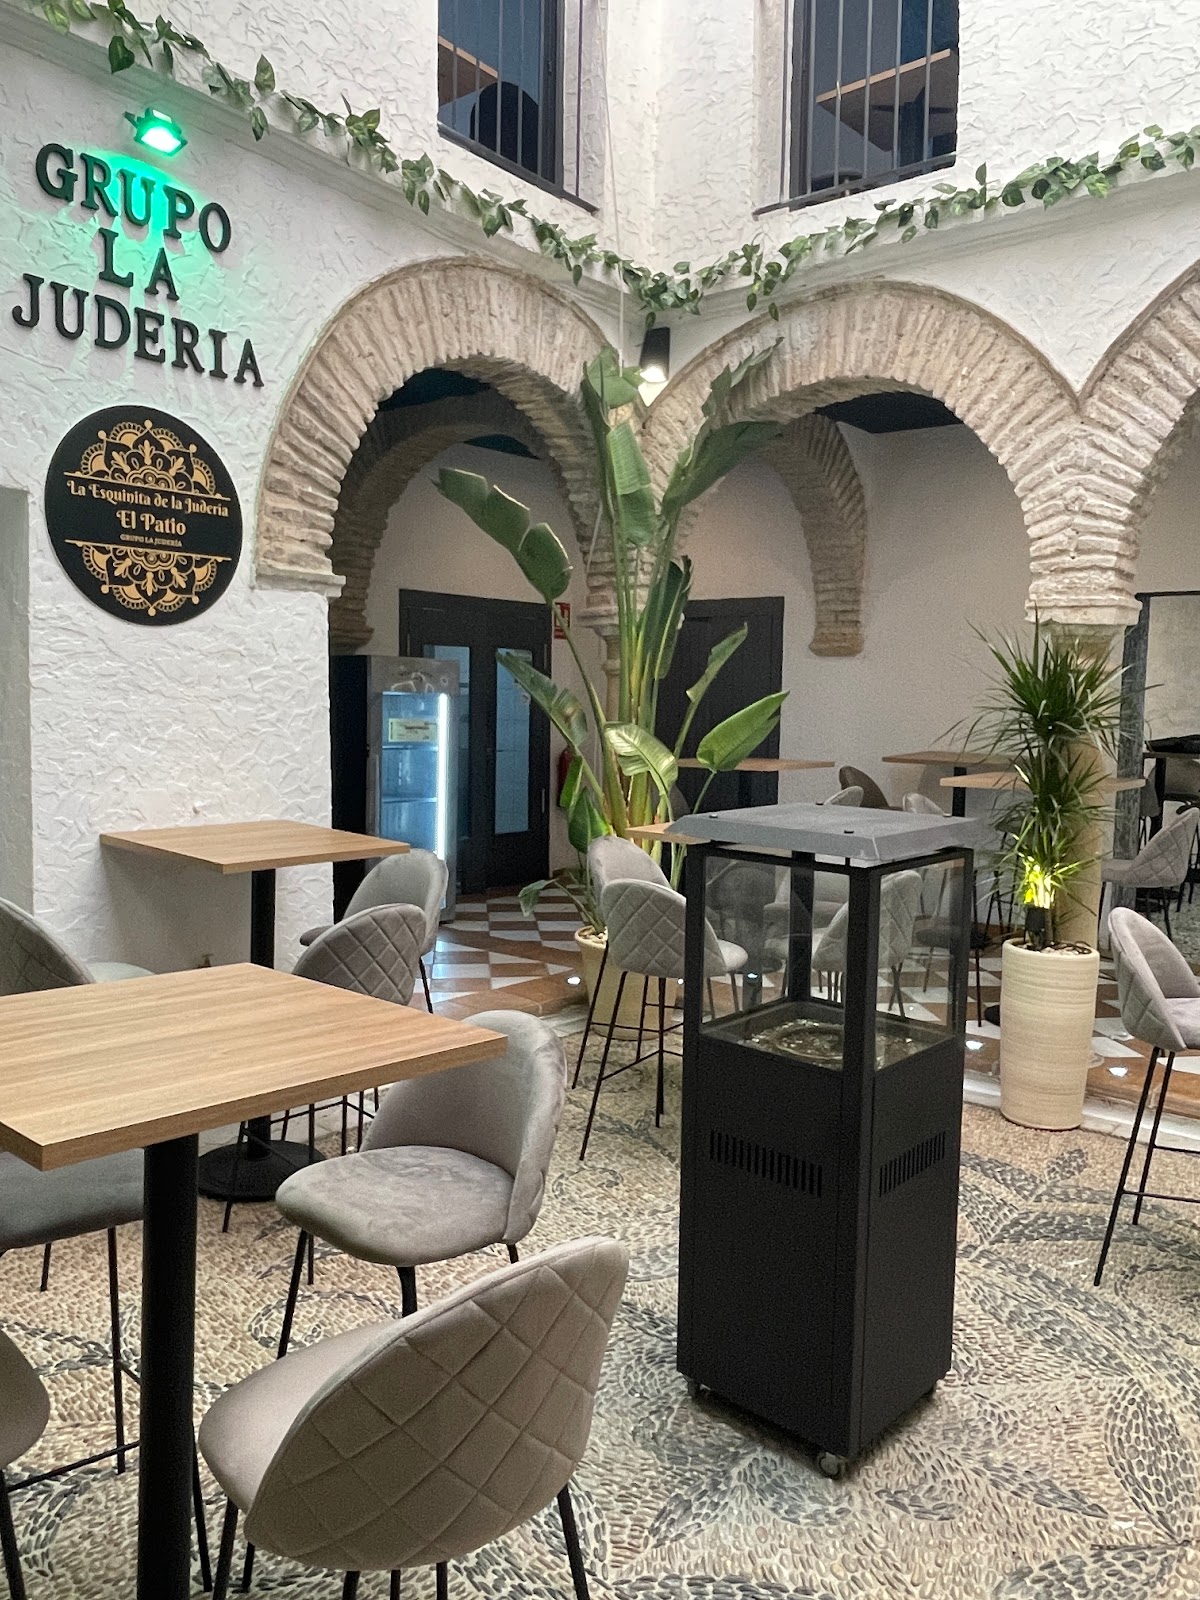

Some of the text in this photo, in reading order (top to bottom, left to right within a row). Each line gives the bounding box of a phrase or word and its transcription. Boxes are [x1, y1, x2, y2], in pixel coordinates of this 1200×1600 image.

[36, 143, 232, 253] GRUPO
[98, 227, 180, 301] LA
[12, 273, 265, 388] JUDERIA
[66, 480, 86, 497] La
[88, 484, 151, 506] Esquinita
[153, 493, 169, 508] de
[171, 495, 183, 510] la
[116, 510, 187, 535] El Patio
[119, 533, 145, 543] GRUPO
[144, 536, 154, 544] LA
